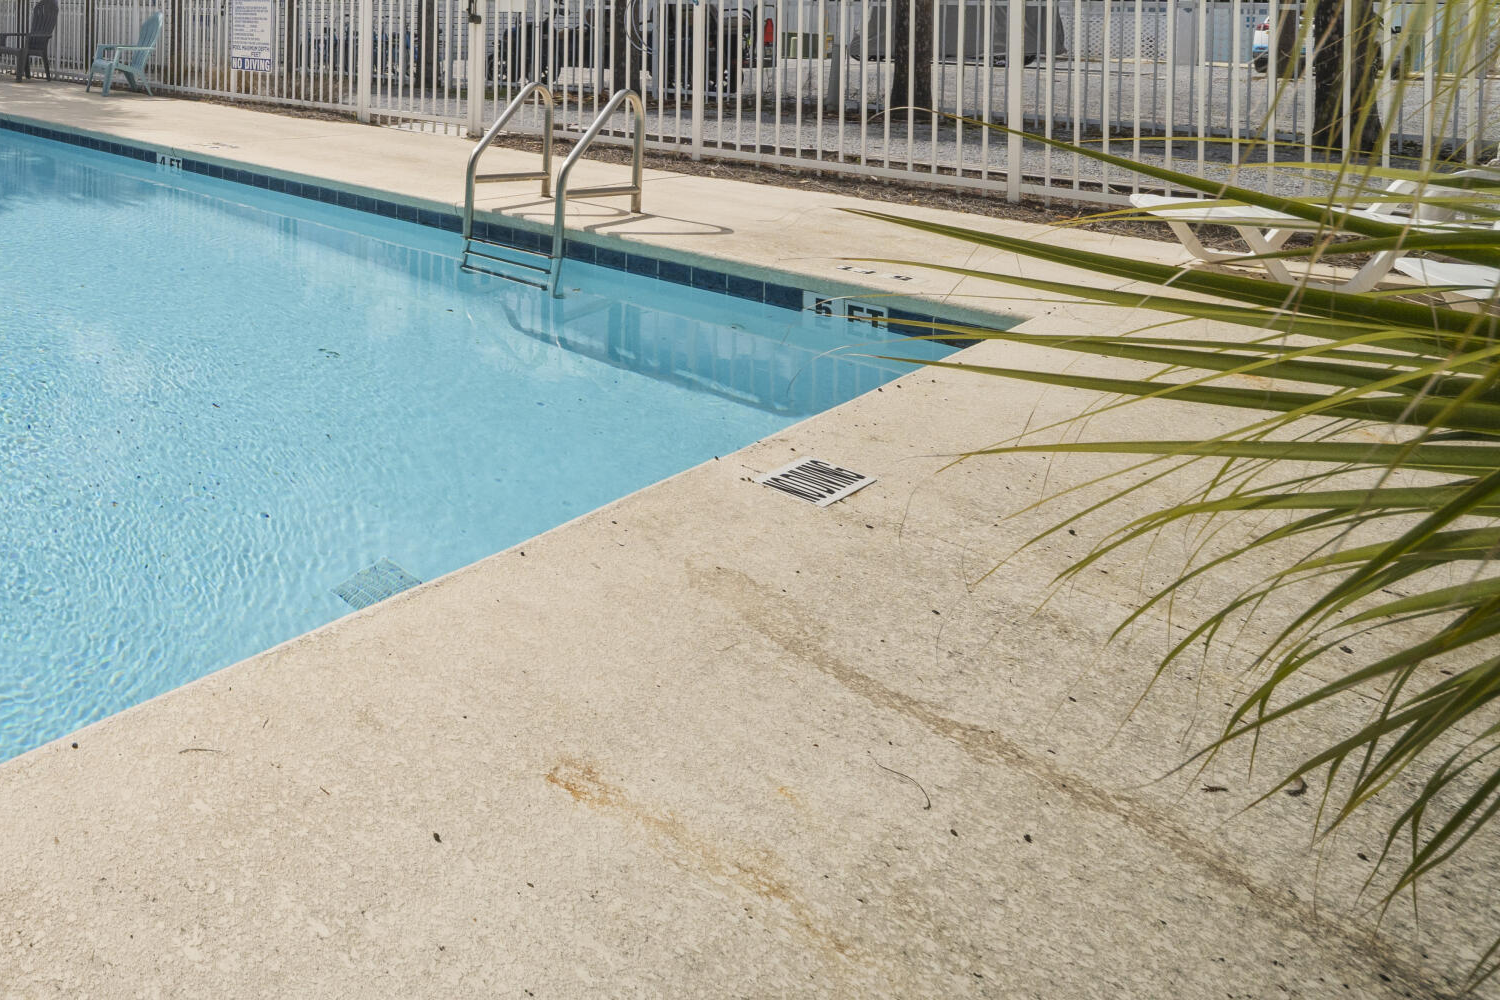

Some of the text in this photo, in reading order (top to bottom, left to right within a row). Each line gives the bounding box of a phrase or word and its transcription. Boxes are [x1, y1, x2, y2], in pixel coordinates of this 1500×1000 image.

[232, 57, 270, 71] NO DIVING
[815, 297, 833, 318] 5
[762, 460, 867, 503] NO DIVING
